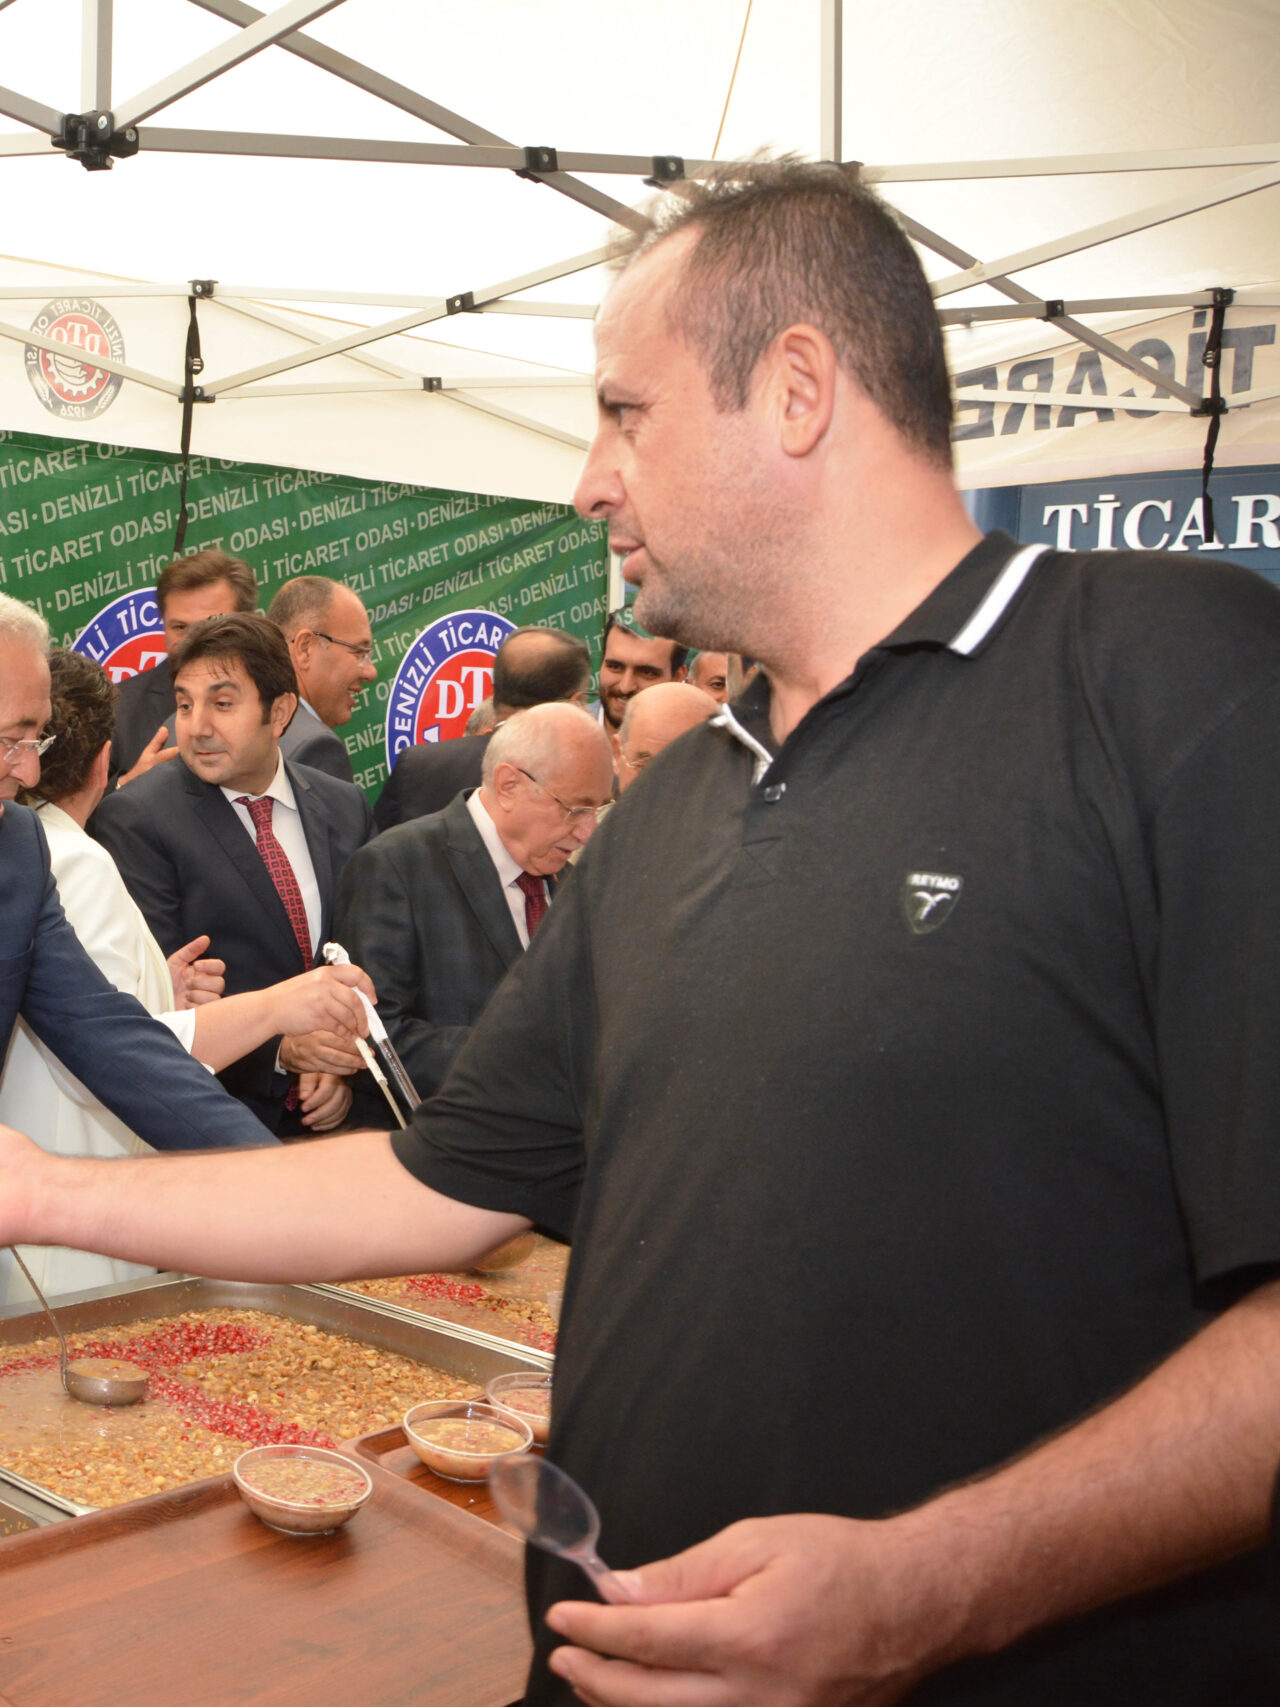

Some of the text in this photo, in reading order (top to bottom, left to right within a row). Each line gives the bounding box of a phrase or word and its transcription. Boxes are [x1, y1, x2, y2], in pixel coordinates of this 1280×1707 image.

[11, 531, 104, 578] TİCARET
[109, 508, 173, 547] ODASI
[185, 478, 259, 524] DENİZLİ
[41, 474, 124, 524] DENİZLİ
[55, 561, 133, 612] DENİZLİ
[230, 516, 290, 552] ODASI
[299, 487, 367, 531] DENİZLİ
[273, 537, 351, 579] TİCARET
[355, 517, 409, 552] ODASI
[378, 543, 450, 584] TİCARET
[454, 523, 505, 557] ODASI
[423, 562, 484, 605] DENİZLİ
[486, 540, 555, 580] TİCARET
[557, 522, 604, 555] ODASI
[520, 565, 579, 607] DENİZLİ
[394, 642, 436, 755] DENİZLİ
